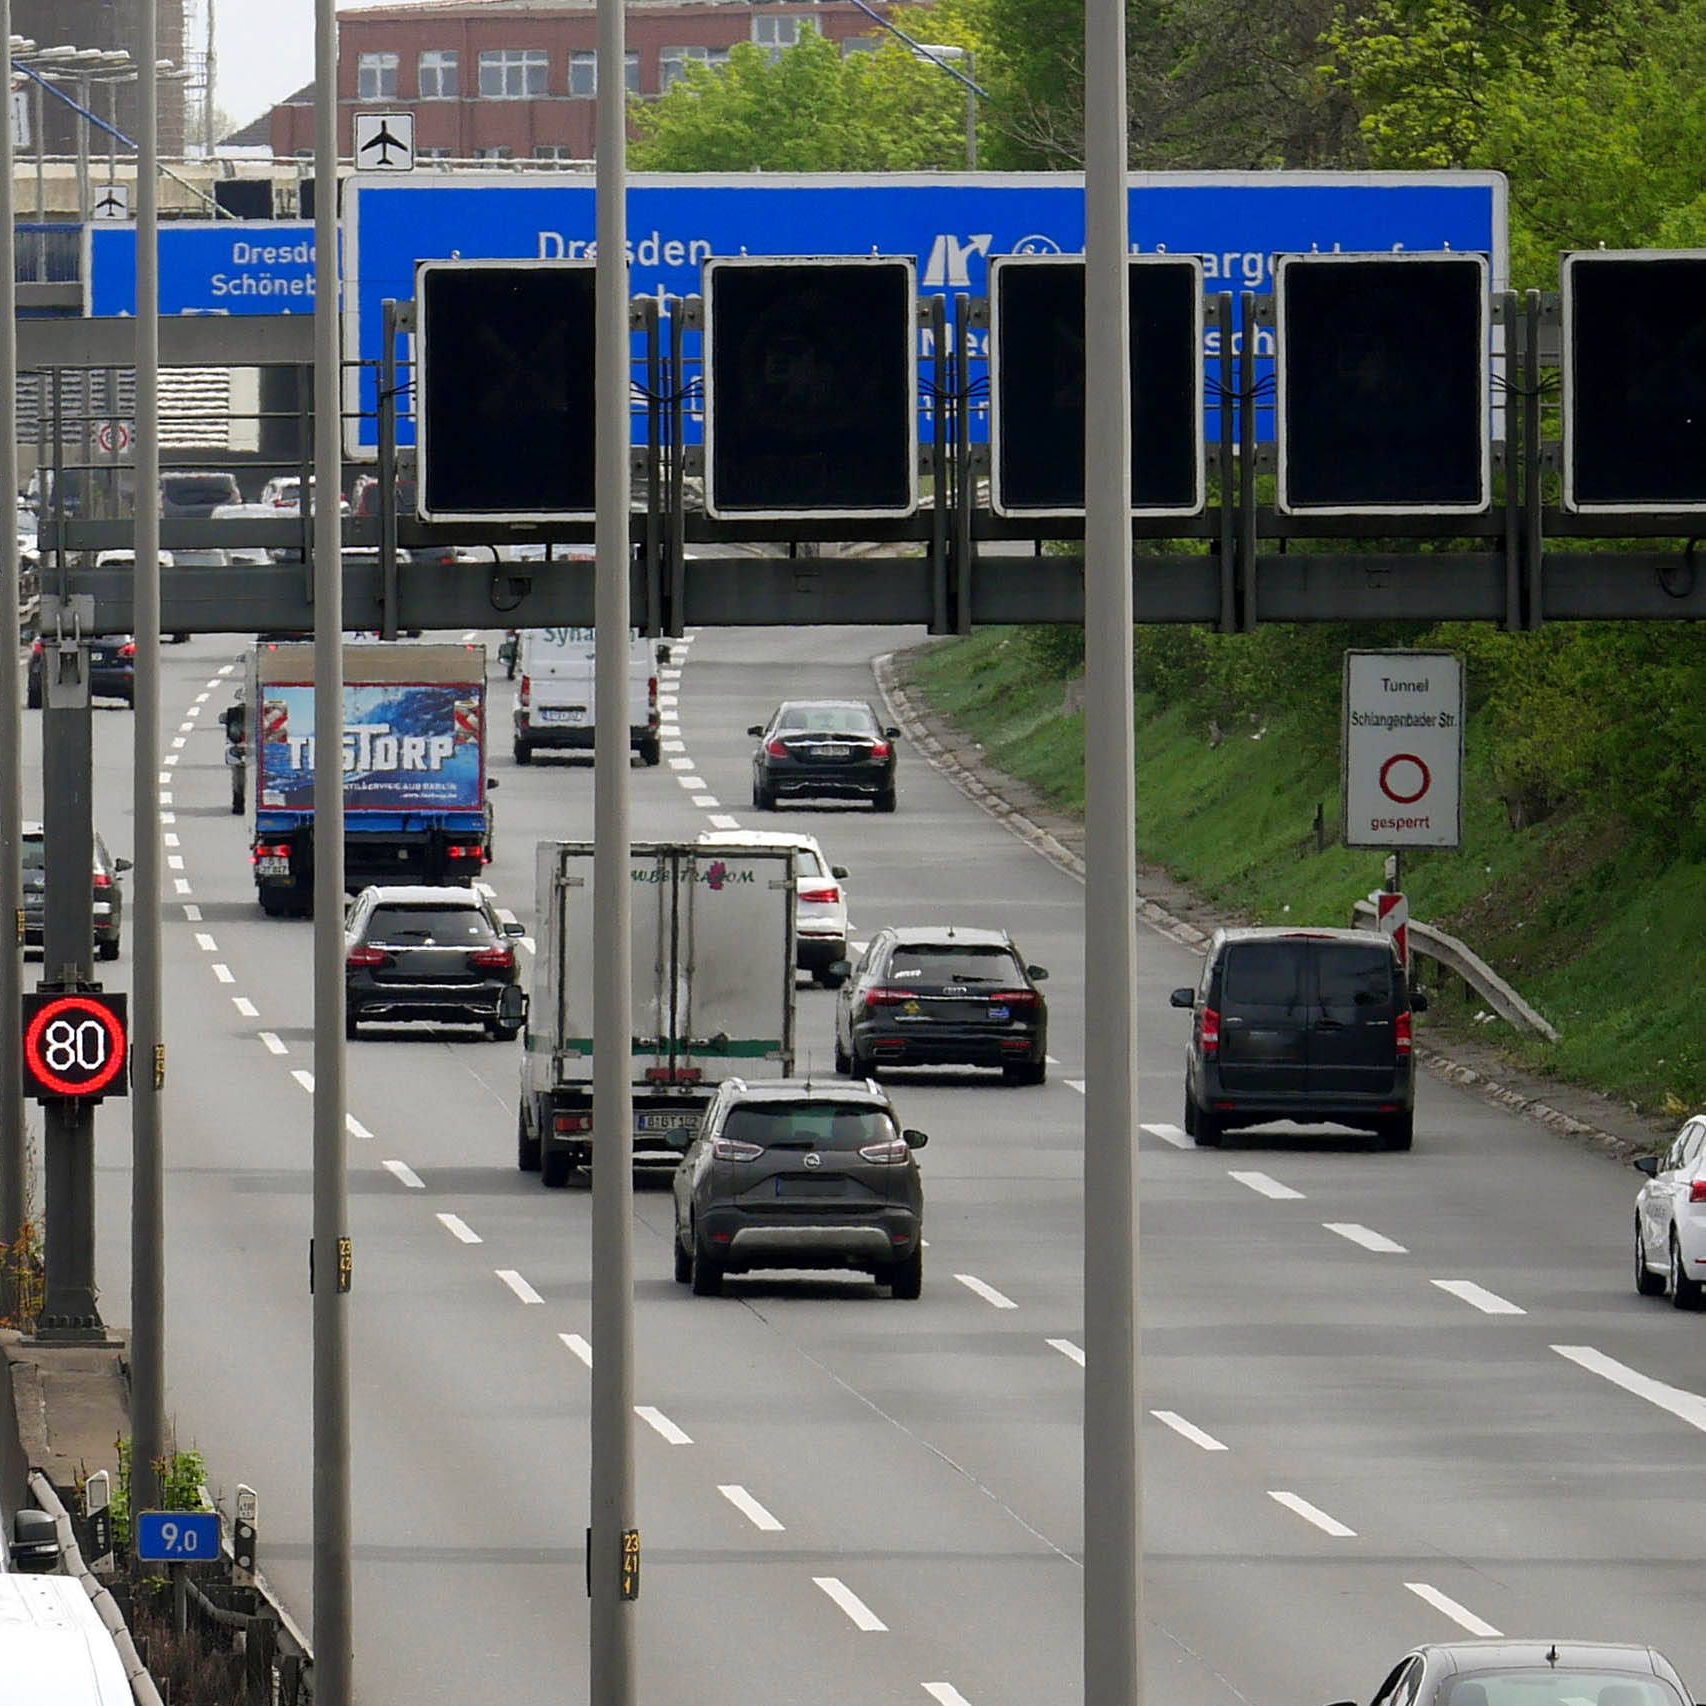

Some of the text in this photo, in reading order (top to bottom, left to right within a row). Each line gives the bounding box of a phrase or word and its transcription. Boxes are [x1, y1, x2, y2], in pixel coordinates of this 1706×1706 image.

[1381, 678, 1429, 693] Tunnel
[1351, 711, 1457, 731] Schlangenbader Str.
[1371, 816, 1430, 831] gesperrt
[45, 1019, 106, 1072] 80
[161, 1522, 197, 1552] 9,0
[624, 1534, 639, 1552] 23
